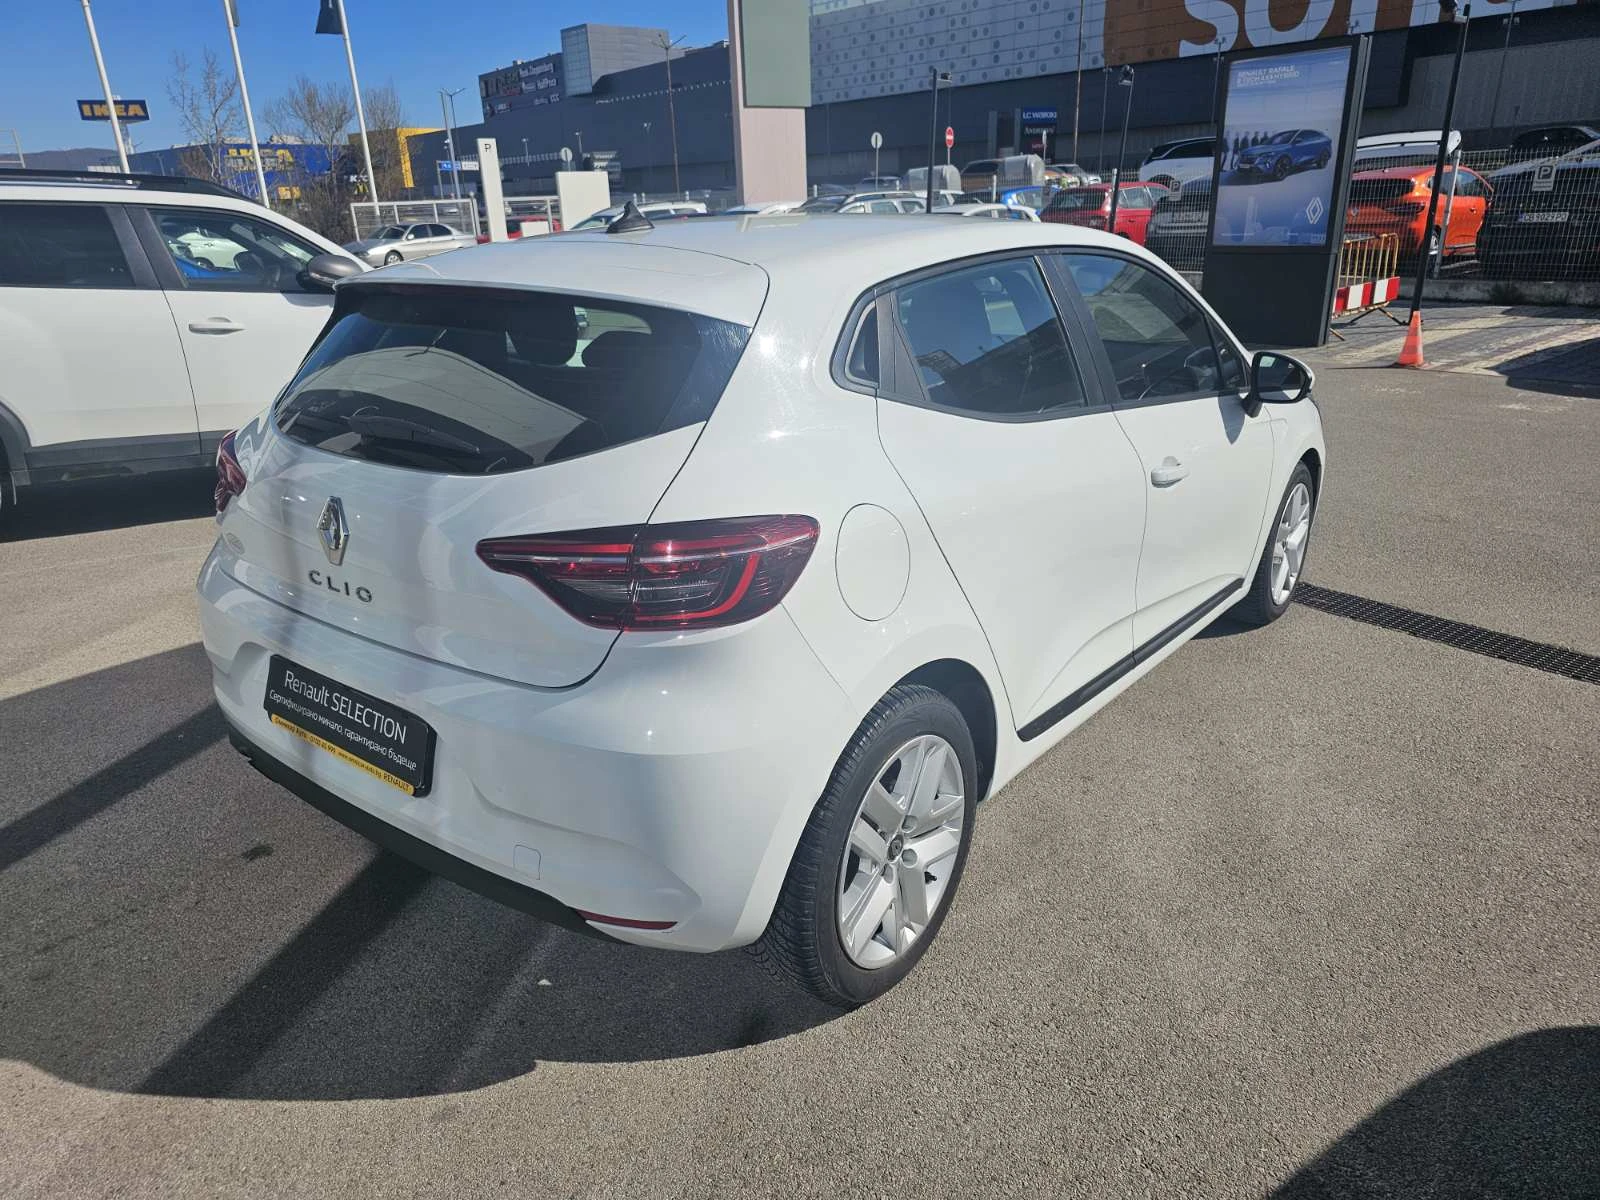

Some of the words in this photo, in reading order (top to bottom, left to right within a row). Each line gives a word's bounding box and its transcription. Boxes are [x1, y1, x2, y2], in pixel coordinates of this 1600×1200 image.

[1540, 166, 1551, 179] P
[309, 570, 372, 603] CLIO
[284, 670, 330, 707] Renault
[331, 692, 407, 744] SELECTION
[344, 728, 387, 756] гарантирано
[388, 747, 417, 771] бъдеще
[383, 772, 410, 792] RENAULT
